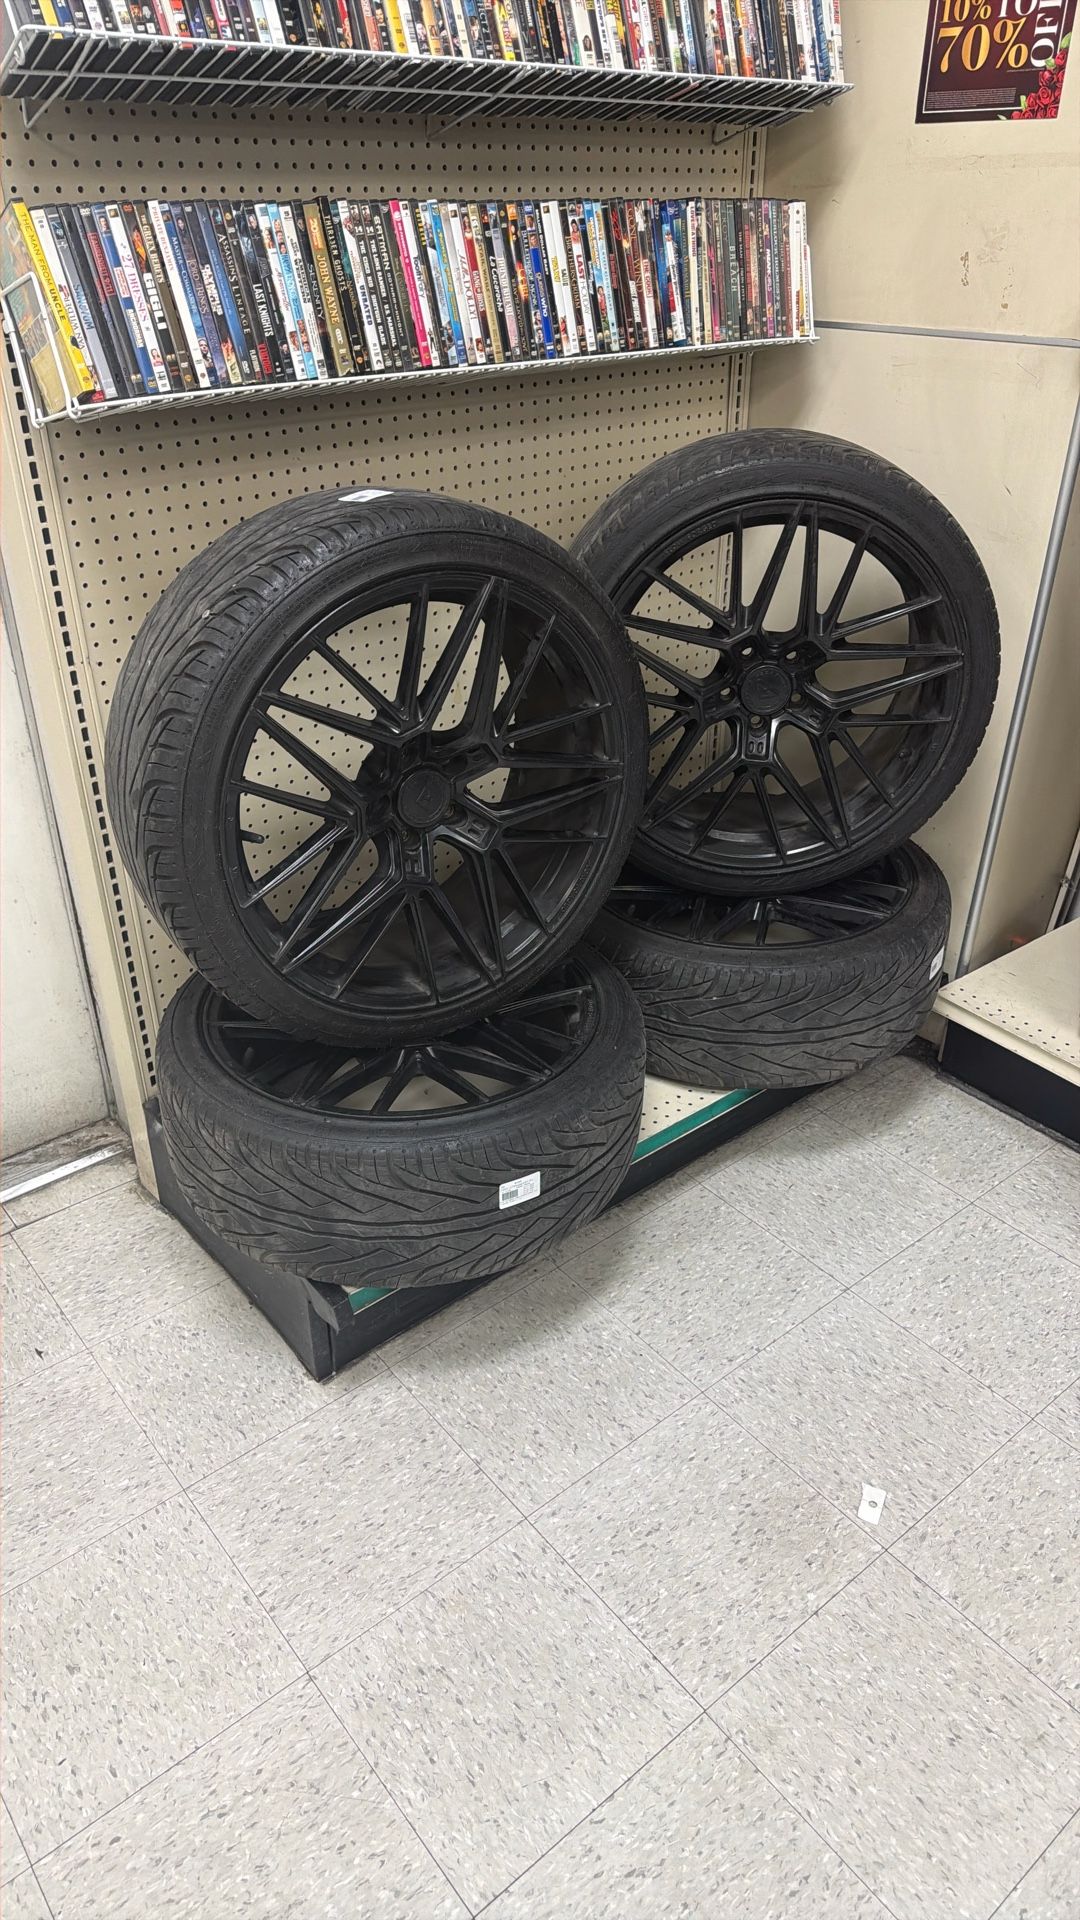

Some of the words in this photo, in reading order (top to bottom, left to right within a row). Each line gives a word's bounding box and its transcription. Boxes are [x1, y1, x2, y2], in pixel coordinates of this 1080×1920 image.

[936, 17, 1029, 73] 70%
[687, 205, 697, 222] LOVE
[19, 211, 32, 231] THE
[28, 233, 41, 256] MAN
[37, 257, 52, 286] FROM
[150, 205, 164, 234] PRIVATE
[159, 235, 175, 272] BENJAMIN
[358, 239, 366, 253] THE
[369, 239, 377, 253] THE
[371, 214, 392, 270] BATMAN
[534, 208, 542, 233] MILLION
[538, 234, 546, 257] DOLLAR
[121, 253, 134, 270] 27
[141, 224, 157, 252] GREEN
[149, 252, 166, 283] BERETS
[170, 235, 184, 265] MASTER
[361, 255, 371, 274] CISCO
[372, 253, 381, 270] LONE
[476, 243, 487, 266] STAR
[489, 254, 498, 266] La
[562, 235, 579, 278] BROTHERS
[625, 207, 638, 240] GONE
[632, 257, 644, 292] WIND
[764, 248, 772, 272] MEAN
[292, 258, 307, 303] WESTERN
[296, 257, 311, 303] AMERICAN
[315, 253, 331, 284] JOHN
[333, 258, 348, 291] GHOSTS
[366, 275, 374, 287] KID
[480, 267, 493, 292] WARS
[520, 229, 535, 281] BULLETPROOF
[528, 282, 537, 306] MONK
[575, 253, 586, 280] LAST
[641, 260, 650, 273] THE
[728, 245, 738, 292] BREACH
[125, 272, 151, 322] DRESSES
[193, 285, 211, 314] RINGS
[203, 263, 224, 315] OLYMPUS
[251, 282, 266, 303] LAST
[304, 262, 327, 321] SERENITY
[375, 270, 388, 297] RANGER
[489, 267, 508, 312] Cucaracha
[493, 256, 518, 315] THUNDERHEART
[510, 278, 520, 304] SLAYER
[568, 277, 582, 309] GRIMM
[578, 280, 591, 315] HOLIDAY
[61, 295, 81, 329] WILDER
[141, 271, 168, 330] GIGLI
[230, 284, 253, 334] LINEAGE
[322, 286, 340, 324] WAYNE
[357, 284, 374, 326] UNRATED
[370, 294, 382, 323] SHOTGUN
[384, 271, 398, 303] GOTHAM
[392, 309, 405, 337] KNIGHT
[514, 304, 524, 327] GIANT
[538, 297, 549, 317] who
[256, 303, 274, 337] KNIGHTS
[377, 324, 387, 345] SLADE
[385, 316, 399, 347] MARSHAL
[74, 331, 87, 349] VAN
[520, 335, 528, 352] JACK
